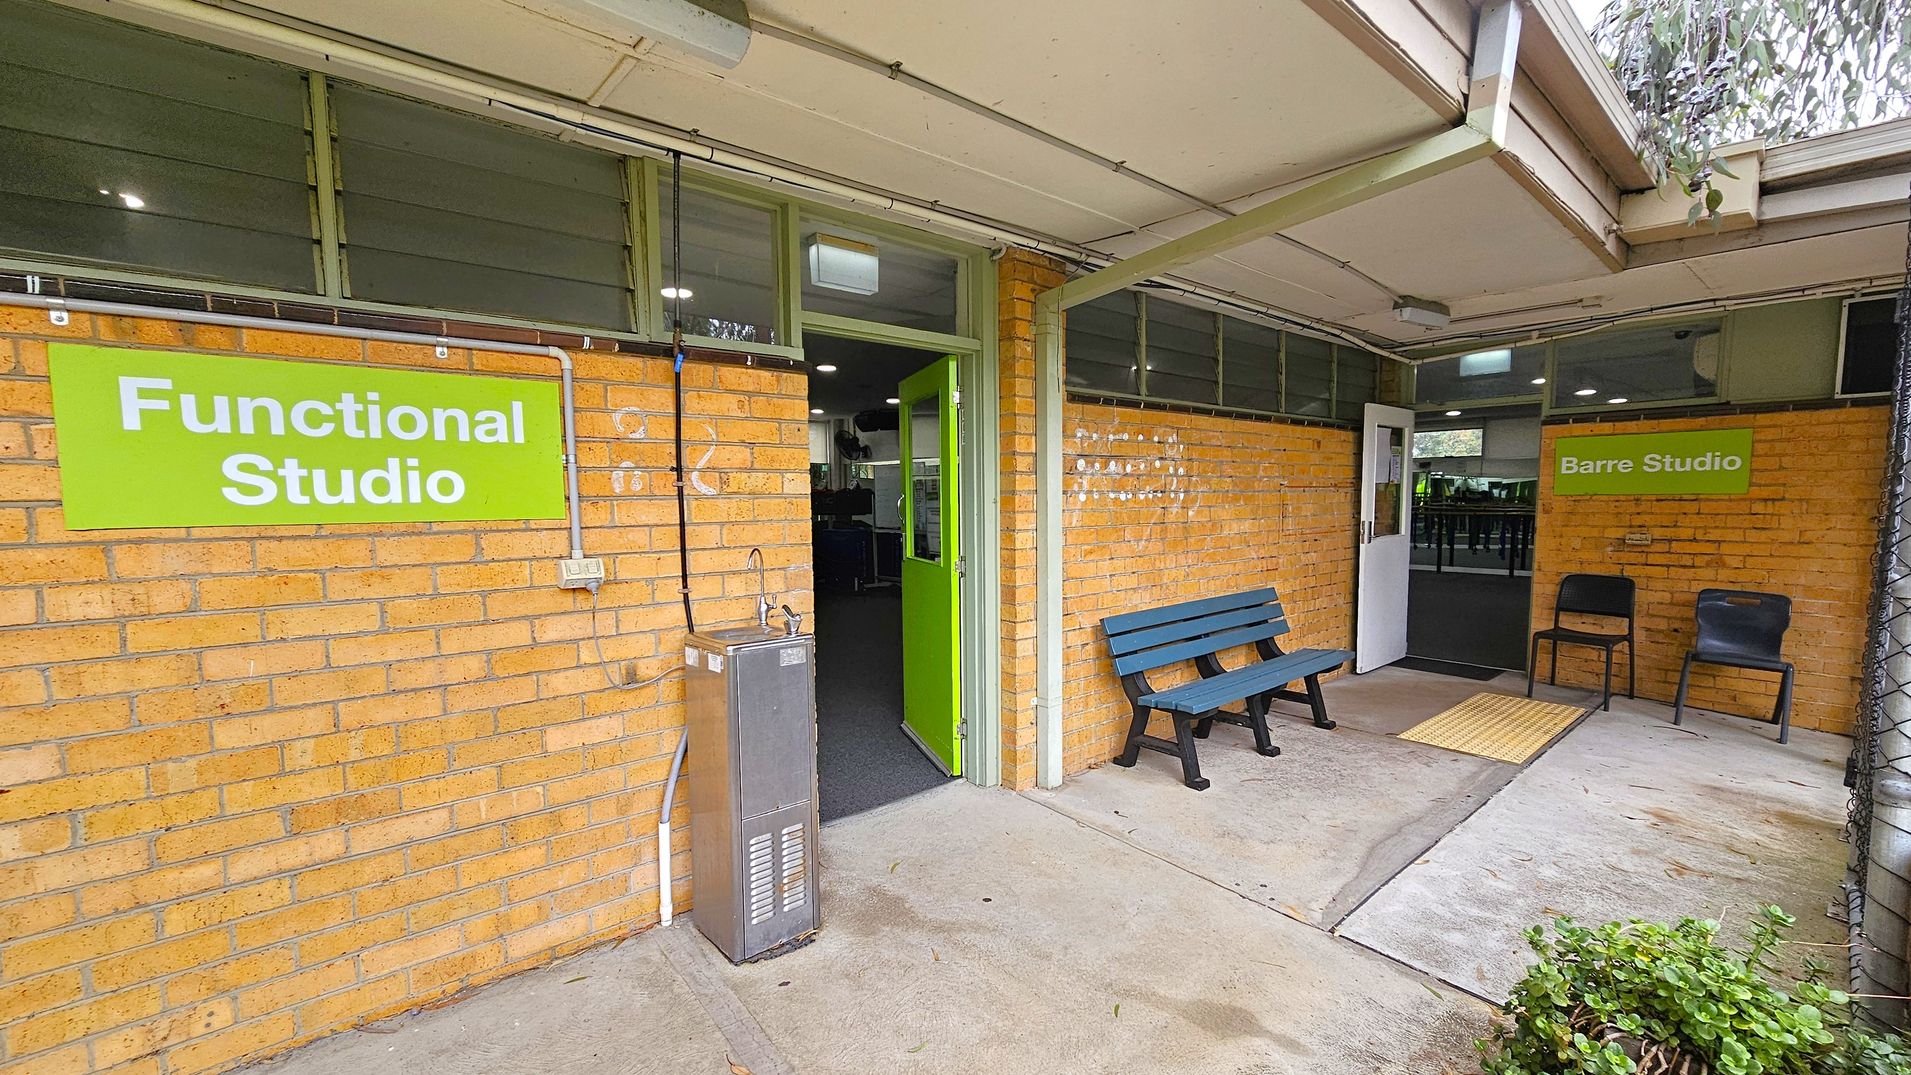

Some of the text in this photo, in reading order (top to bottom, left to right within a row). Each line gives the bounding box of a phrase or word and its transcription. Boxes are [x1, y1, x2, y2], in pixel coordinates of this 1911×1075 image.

[118, 375, 525, 444] Functional
[221, 453, 465, 505] Studio
[1561, 452, 1742, 474] Barre Studio
